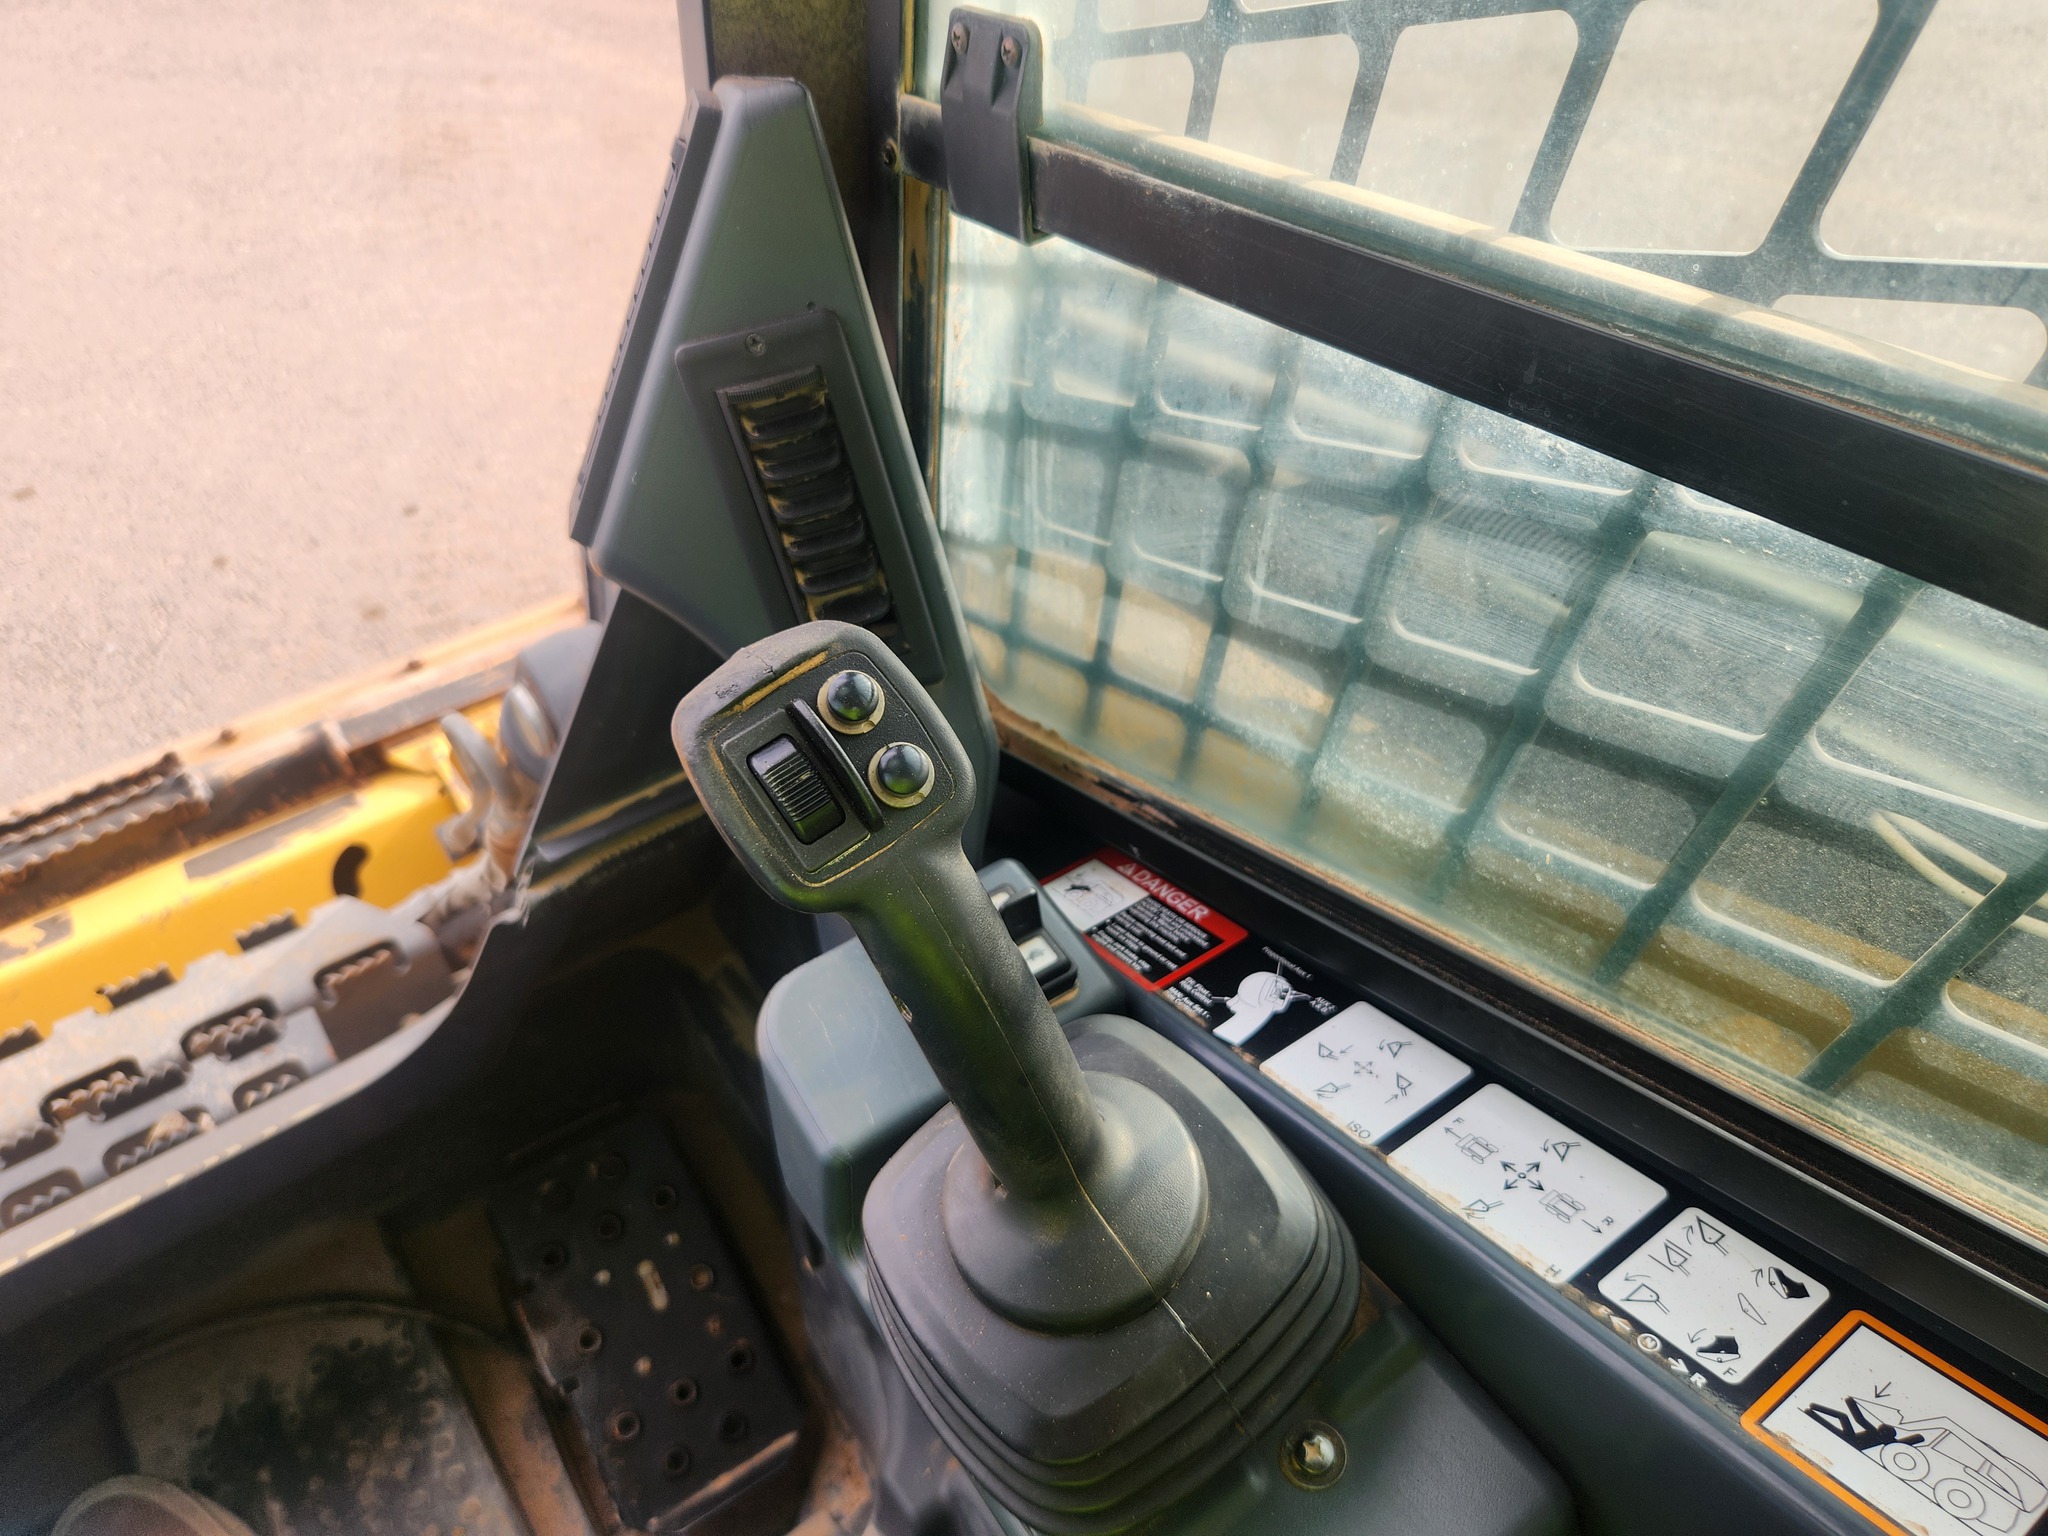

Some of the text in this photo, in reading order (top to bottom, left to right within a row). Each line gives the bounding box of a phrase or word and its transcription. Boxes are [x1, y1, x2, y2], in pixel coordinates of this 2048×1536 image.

[1132, 867, 1210, 920] DANGER
[1261, 945, 1296, 969] Proportional
[1191, 988, 1213, 1006] Control
[1345, 1120, 1371, 1139] ISO
[1452, 1117, 1465, 1125] F
[1601, 1216, 1614, 1226] R
[1690, 1372, 1708, 1388] R
[1723, 1367, 1738, 1377] F
